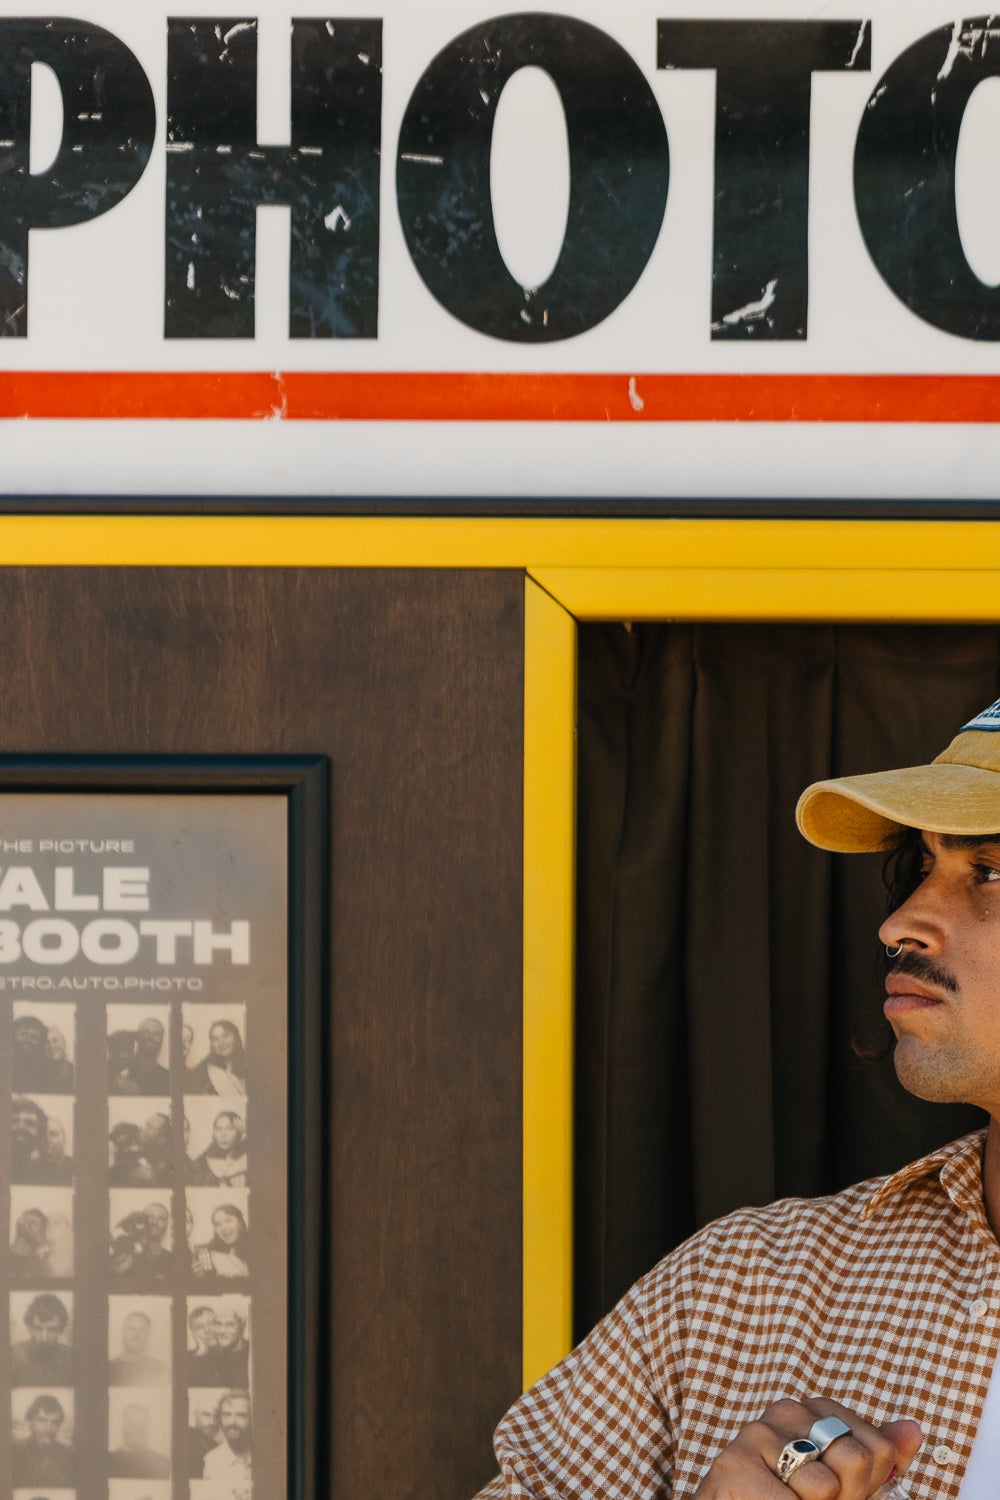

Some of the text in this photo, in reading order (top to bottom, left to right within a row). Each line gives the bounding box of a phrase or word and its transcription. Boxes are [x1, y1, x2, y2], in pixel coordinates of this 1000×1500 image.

[0, 840, 135, 853] HE PICTURE
[0, 866, 149, 911] ALE
